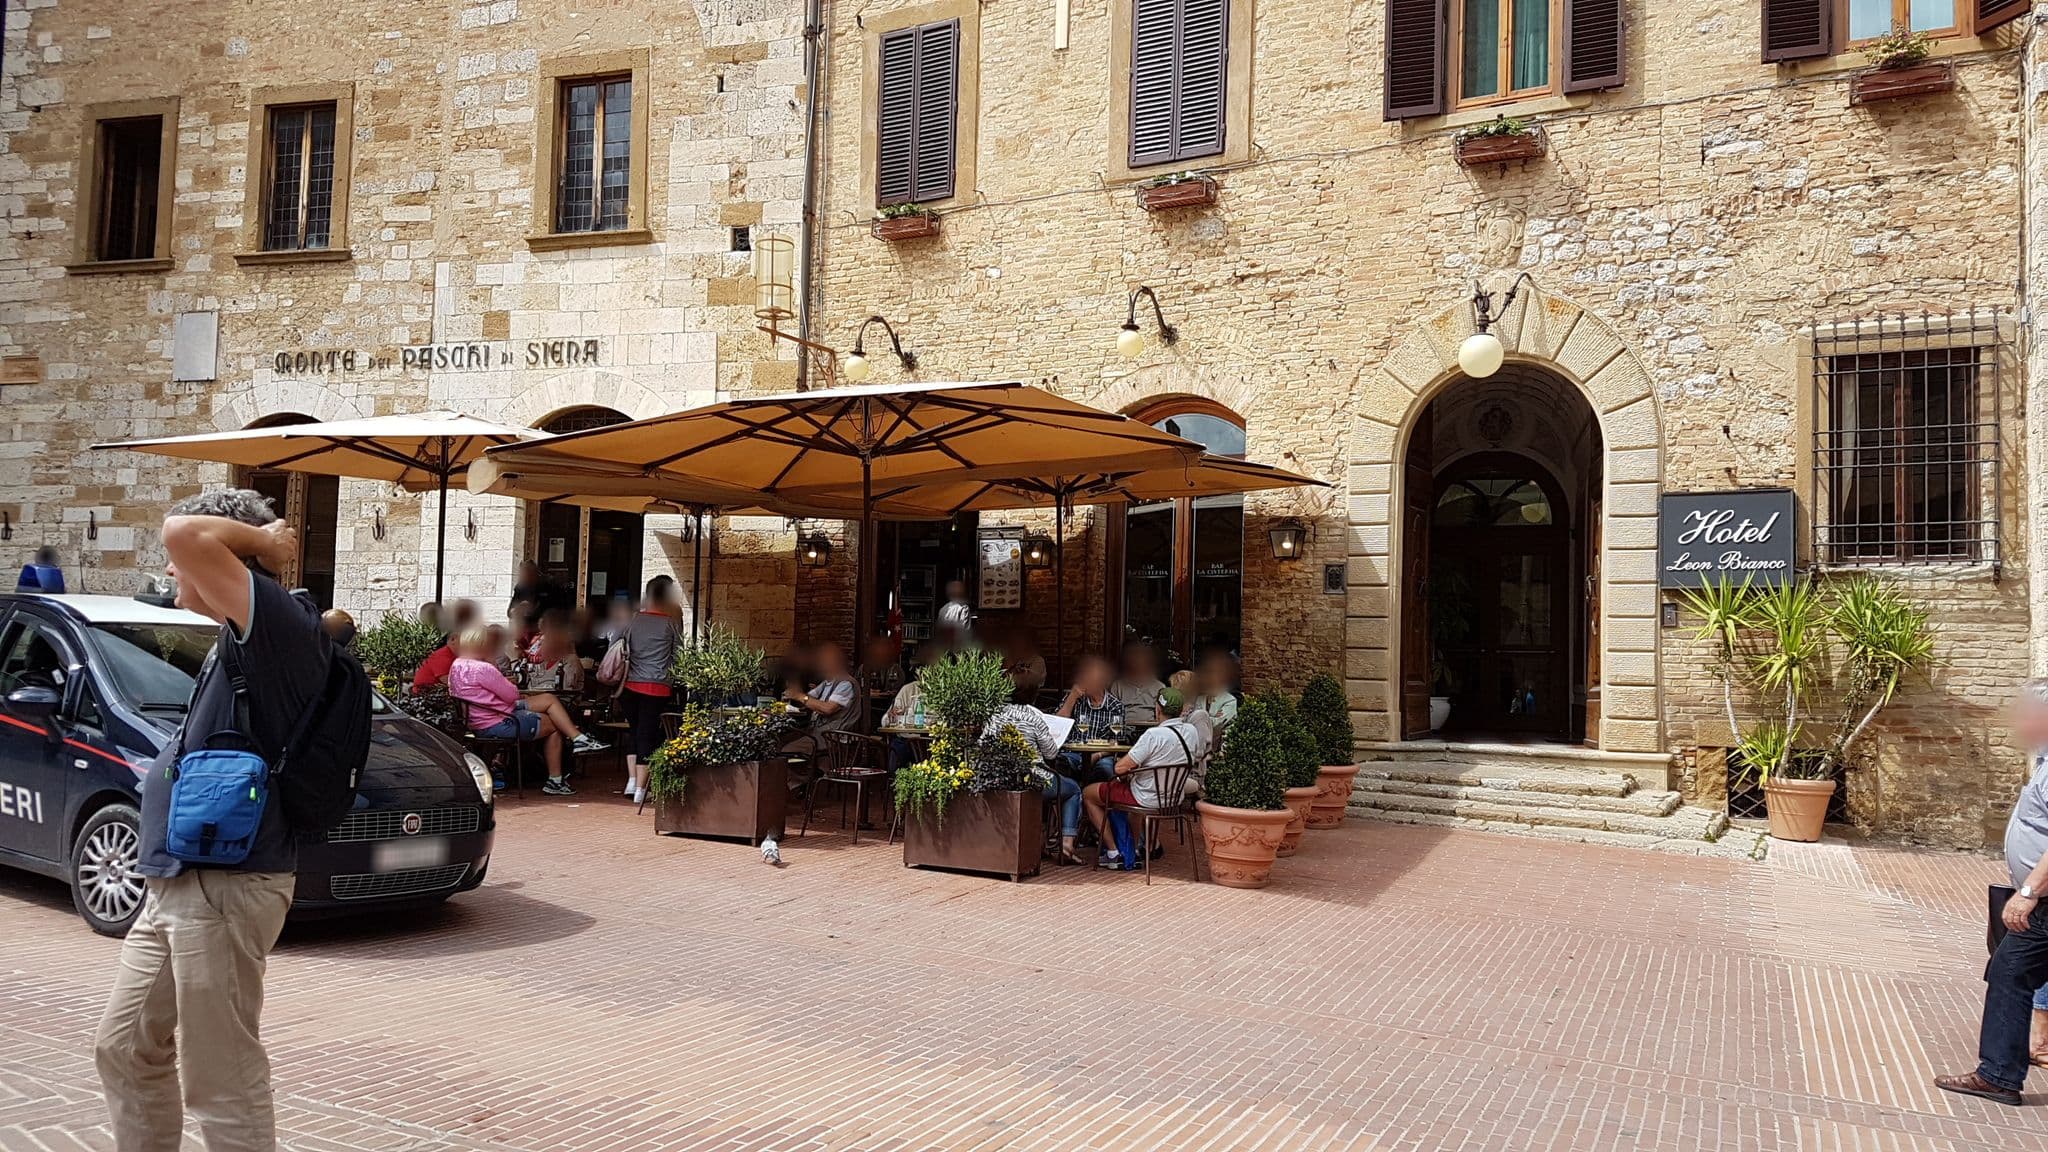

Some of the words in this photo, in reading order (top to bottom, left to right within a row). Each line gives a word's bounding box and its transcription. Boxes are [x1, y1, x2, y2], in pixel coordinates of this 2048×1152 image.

[274, 350, 356, 374] MONTE
[400, 345, 490, 372] PASCHI
[525, 340, 599, 367] SIENA
[1677, 509, 1780, 545] Hotel
[1666, 552, 1713, 571] Leon
[1717, 550, 1787, 570] Bianco
[0, 781, 44, 824] ERI
